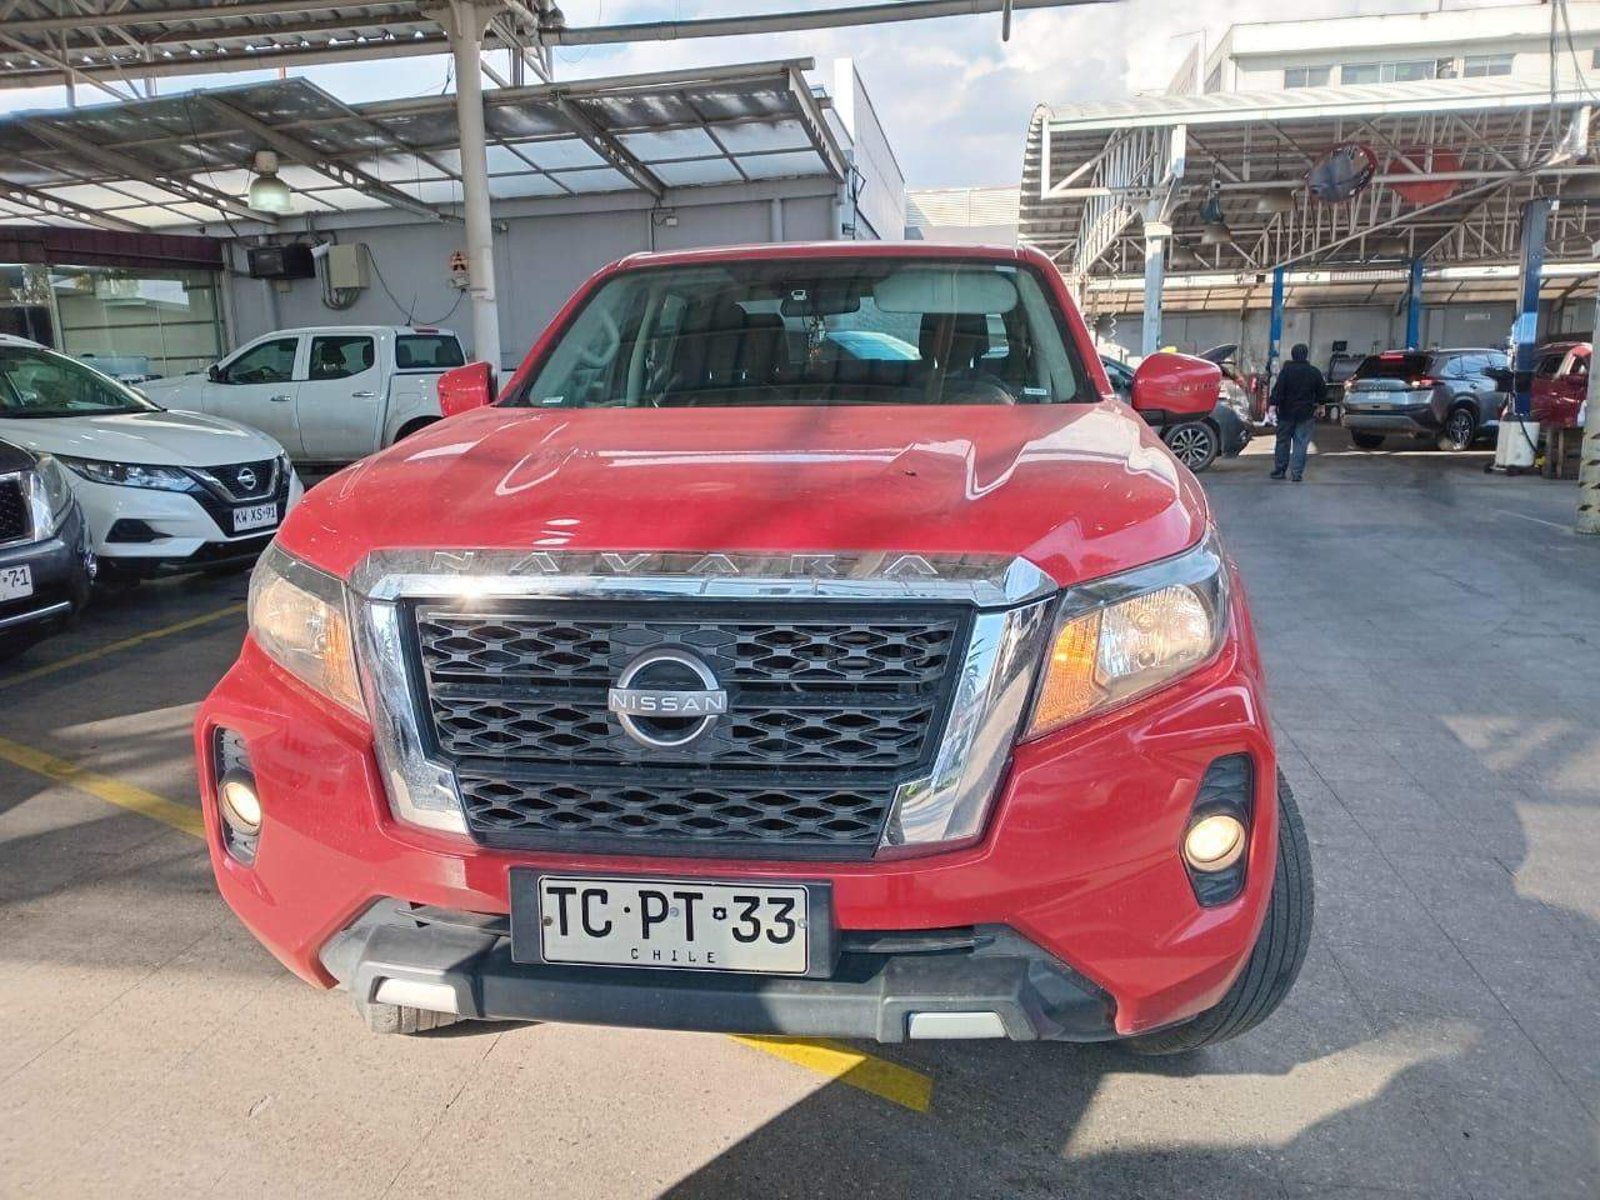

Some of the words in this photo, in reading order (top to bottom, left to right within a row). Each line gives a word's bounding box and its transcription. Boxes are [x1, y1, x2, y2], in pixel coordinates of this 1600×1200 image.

[430, 552, 939, 575] NAVARA
[611, 694, 722, 711] NISSAN
[630, 948, 717, 963] CHILE
